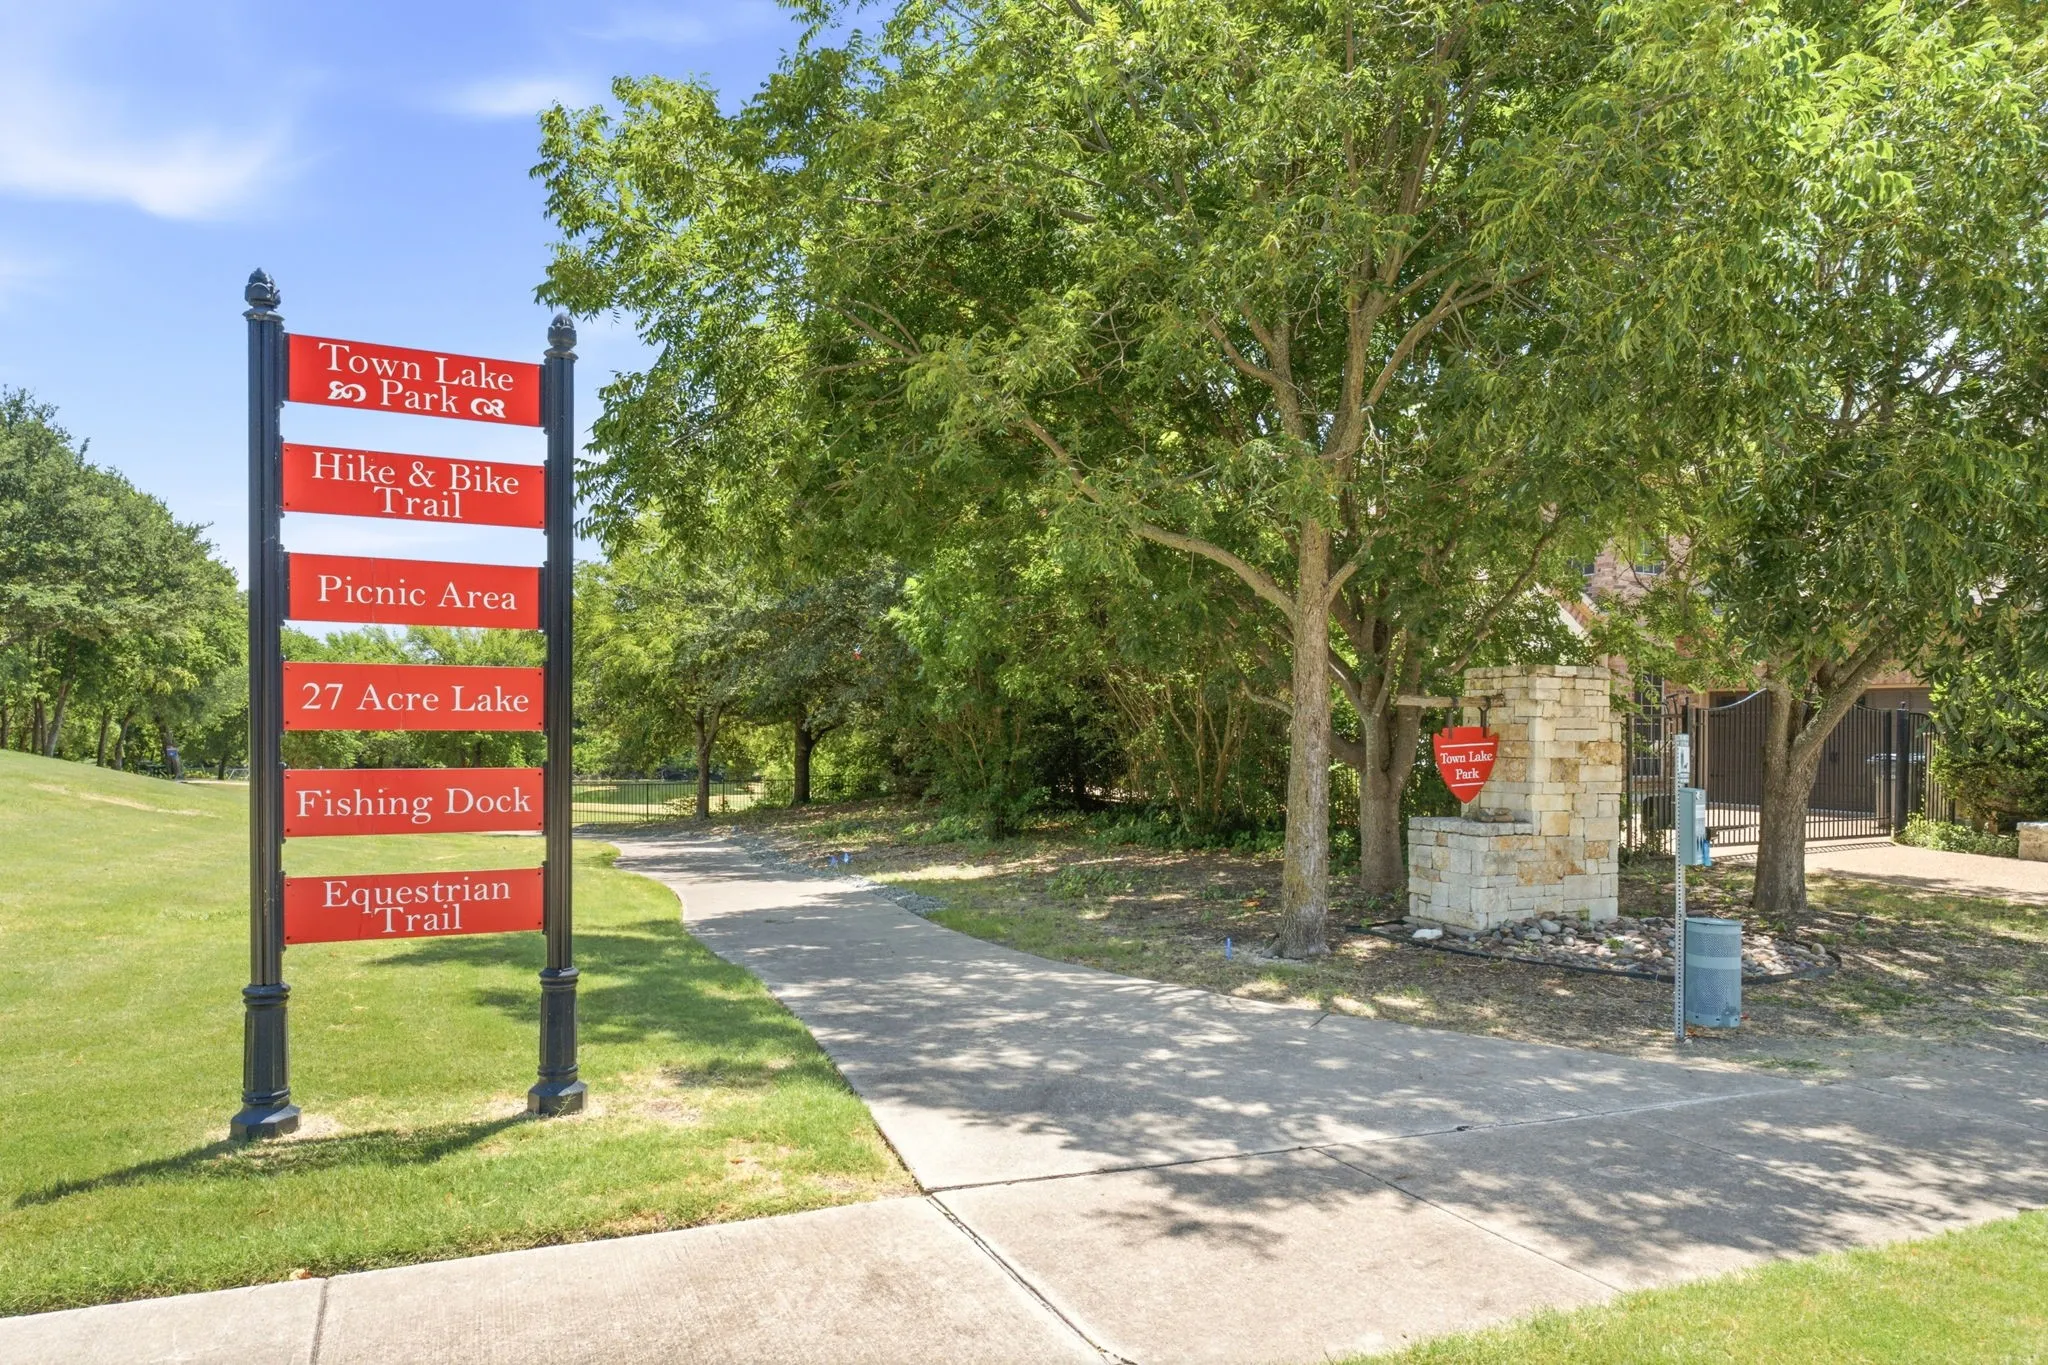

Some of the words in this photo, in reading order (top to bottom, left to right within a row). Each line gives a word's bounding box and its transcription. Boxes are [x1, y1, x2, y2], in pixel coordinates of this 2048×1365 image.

[318, 342, 422, 382] Town
[434, 356, 514, 392] Lake
[379, 378, 460, 414] Park
[312, 451, 396, 487] Hike
[408, 461, 436, 488] &
[448, 463, 519, 495] Bike
[373, 485, 463, 519] Trail
[318, 574, 426, 607] Picnic
[437, 581, 517, 610] Area
[301, 682, 344, 711] 27
[356, 683, 439, 712] Acre
[451, 685, 529, 713] Lake
[1440, 751, 1466, 764] Town
[1469, 750, 1493, 763] Lake
[1456, 767, 1480, 780] Park
[295, 789, 433, 825] Fishing
[444, 786, 532, 814] Dock
[322, 876, 511, 914] Equestrian
[374, 903, 462, 933] Trail
